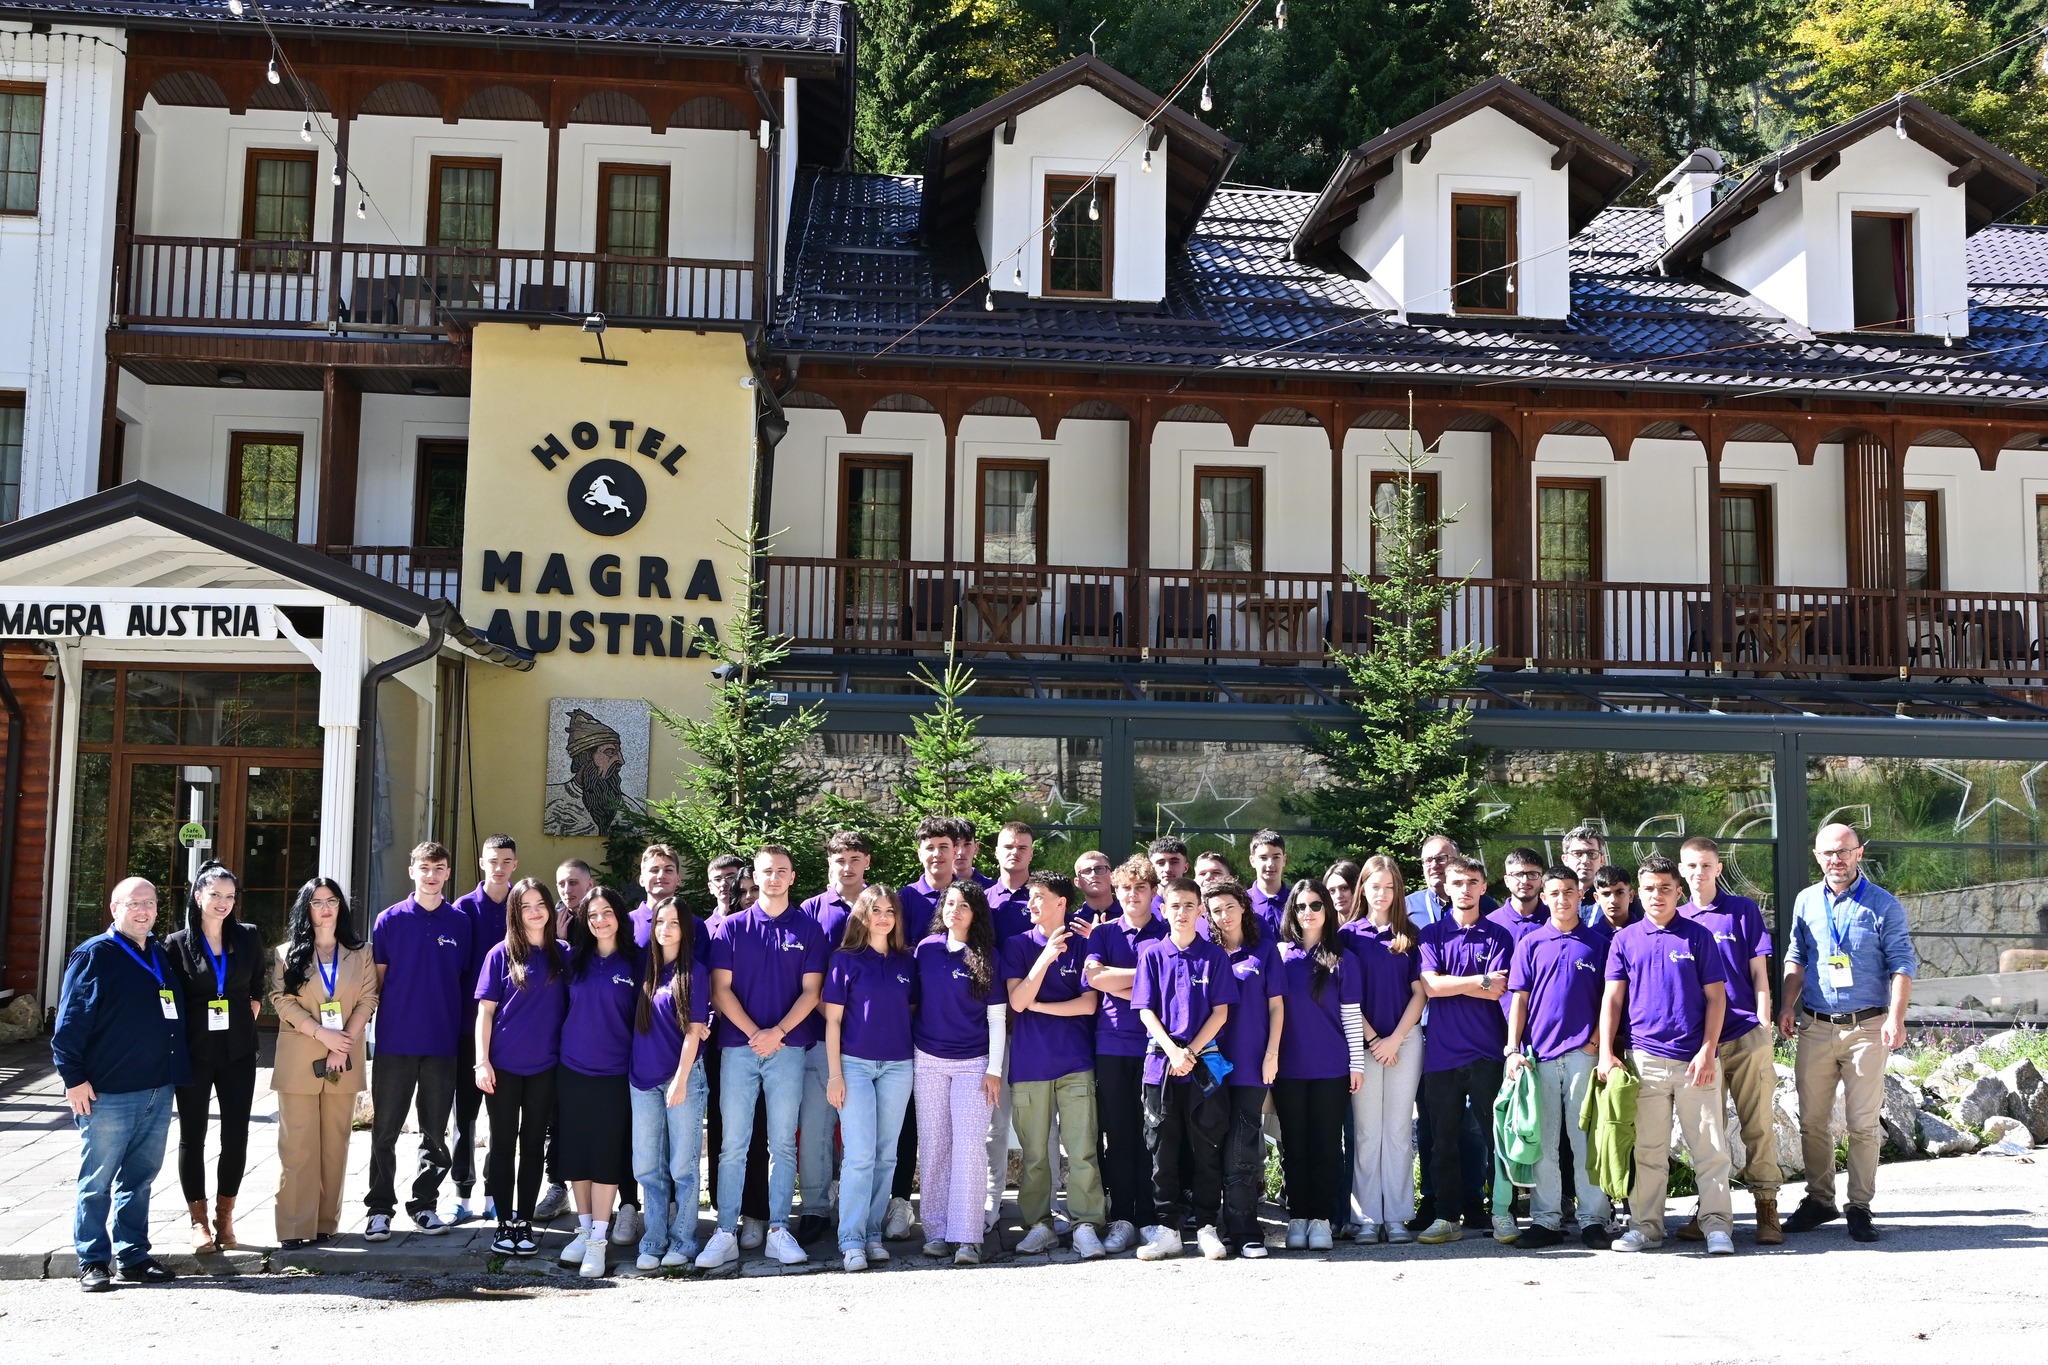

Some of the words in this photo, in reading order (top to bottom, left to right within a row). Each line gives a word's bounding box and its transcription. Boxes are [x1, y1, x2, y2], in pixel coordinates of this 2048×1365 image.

[531, 420, 687, 477] HOTEL
[482, 549, 722, 601] MAGRA
[0, 603, 106, 636] MAGRA
[126, 605, 260, 637] AUSTRIA
[485, 608, 720, 659] AUSTRIA
